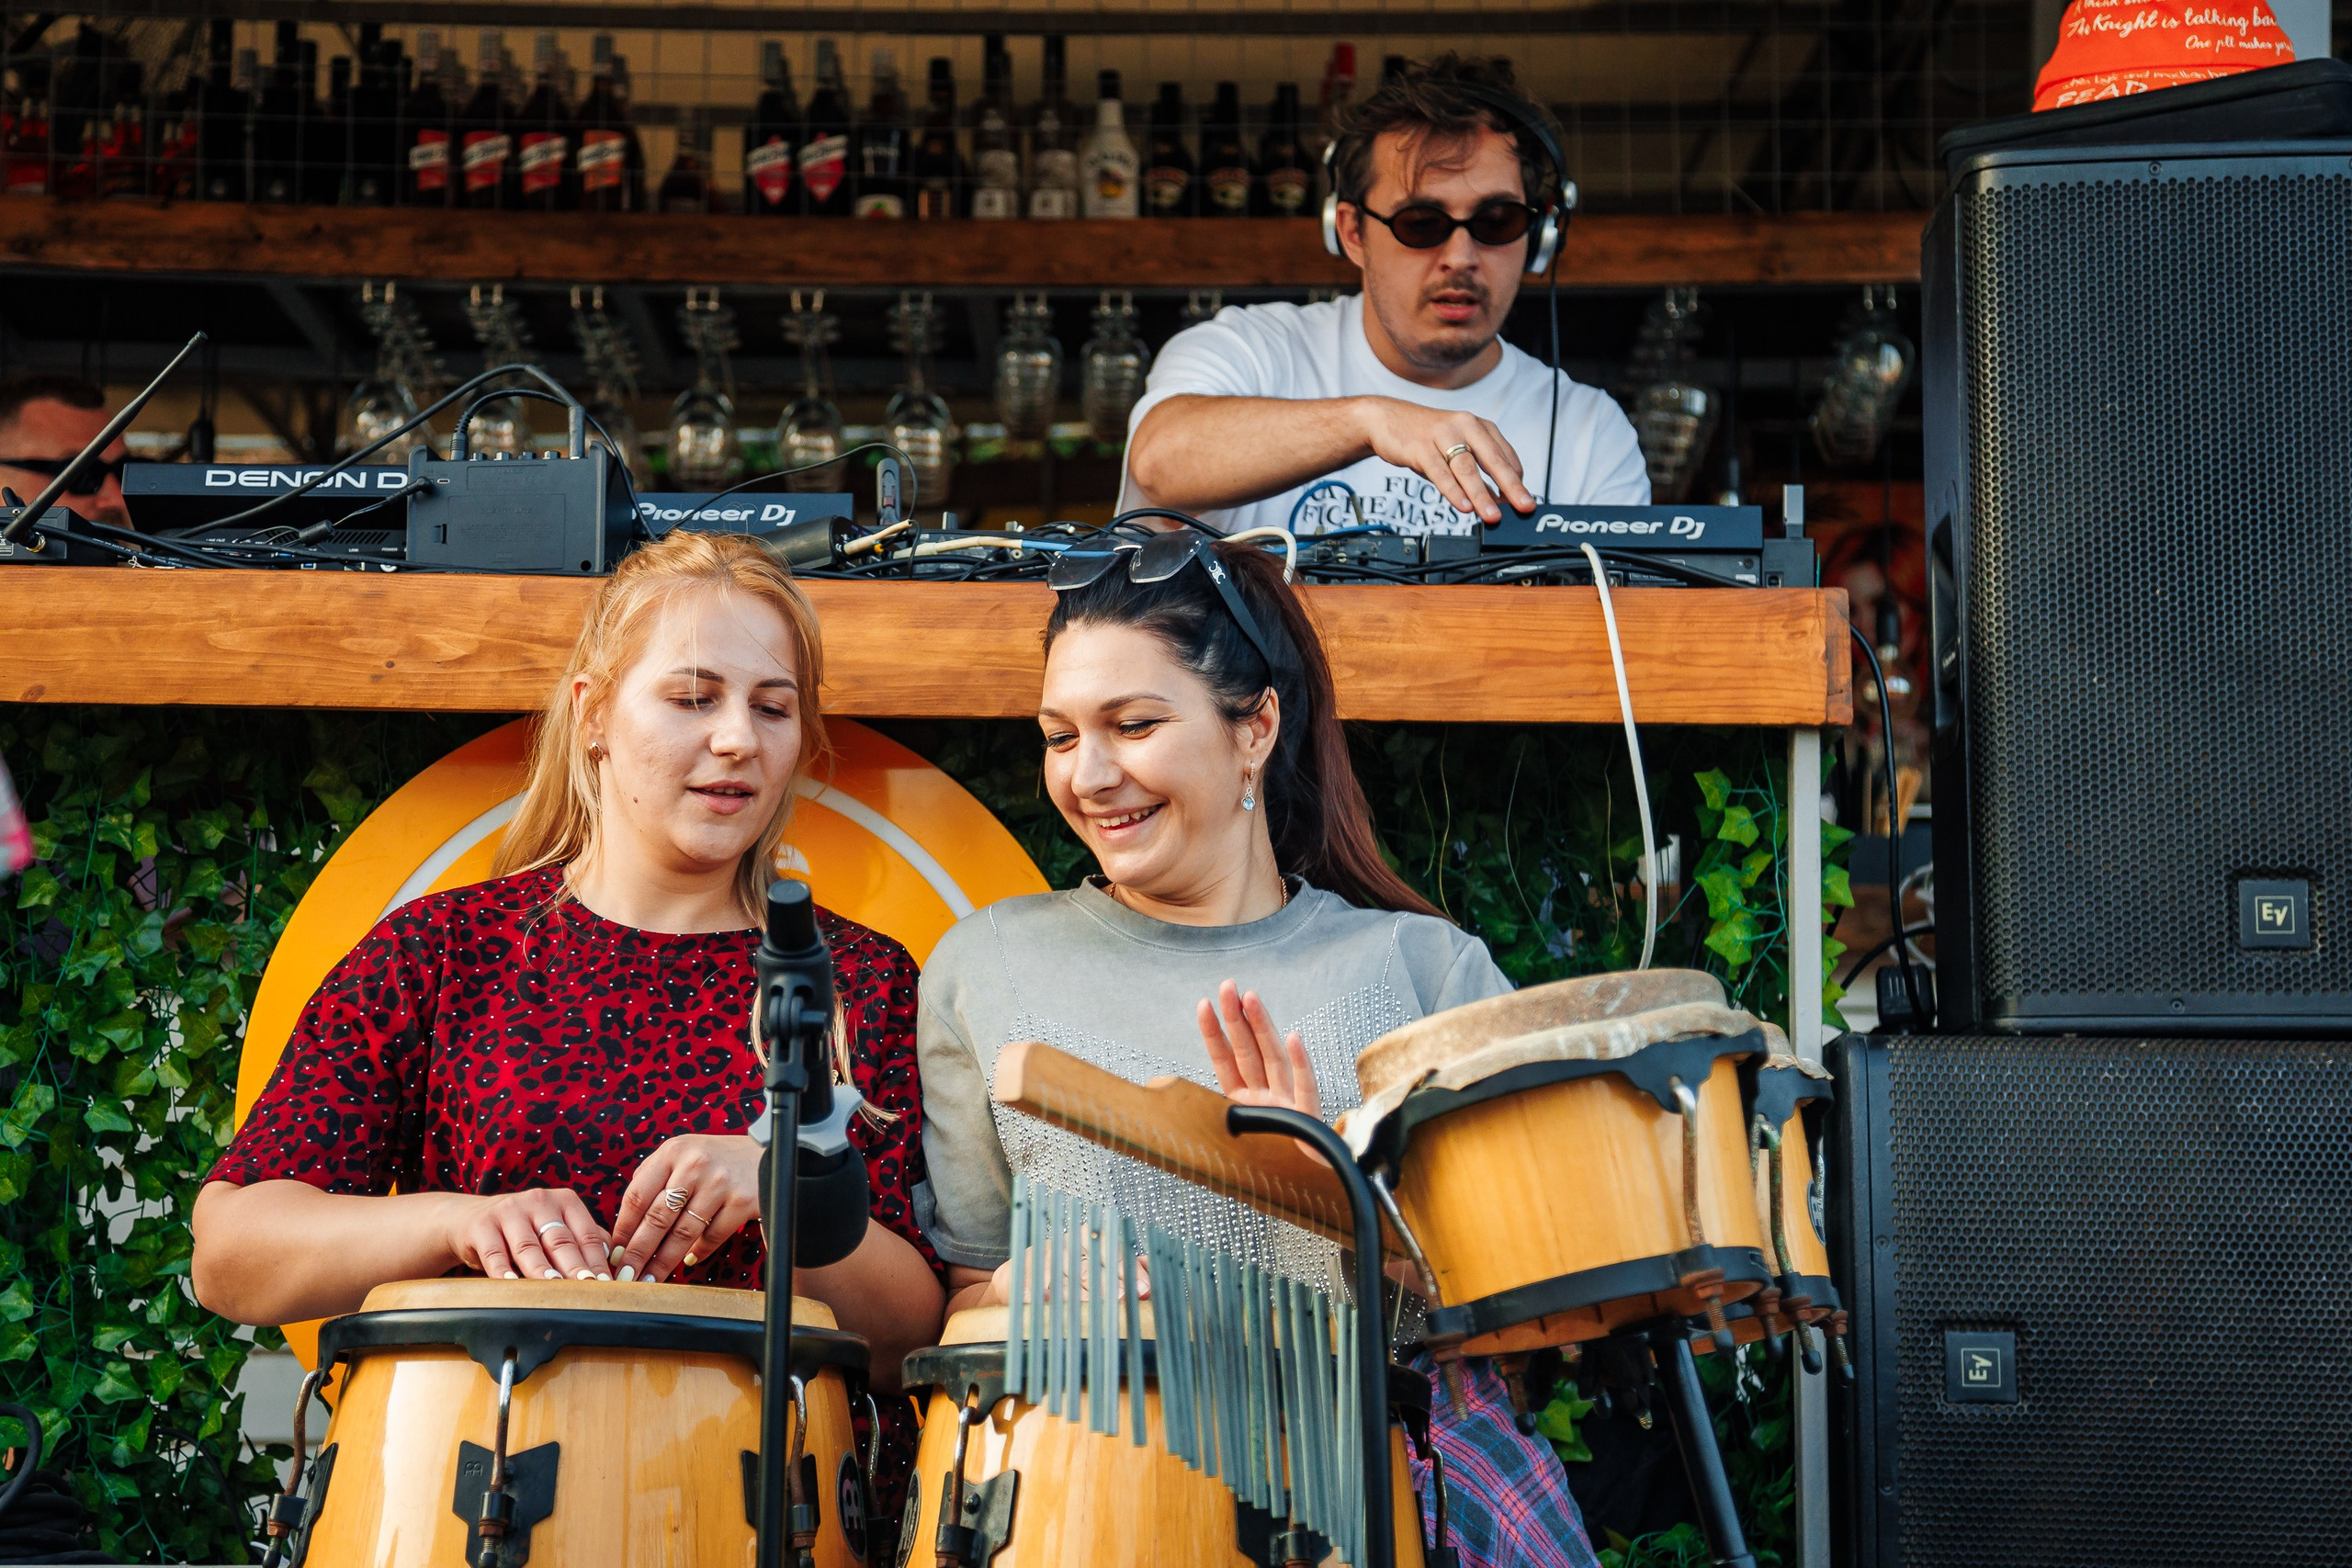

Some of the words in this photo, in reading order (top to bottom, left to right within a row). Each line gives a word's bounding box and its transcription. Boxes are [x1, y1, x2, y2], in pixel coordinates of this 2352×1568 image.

[2092, 9, 2159, 38] Knight
[2161, 15, 2181, 28] is
[2184, 7, 2249, 37] talking
[2185, 34, 2212, 50] One
[205, 469, 367, 489] DENON
[1385, 476, 1443, 504] FUC
[632, 502, 755, 522] Pioneer
[1535, 513, 1663, 534] Pioneer
